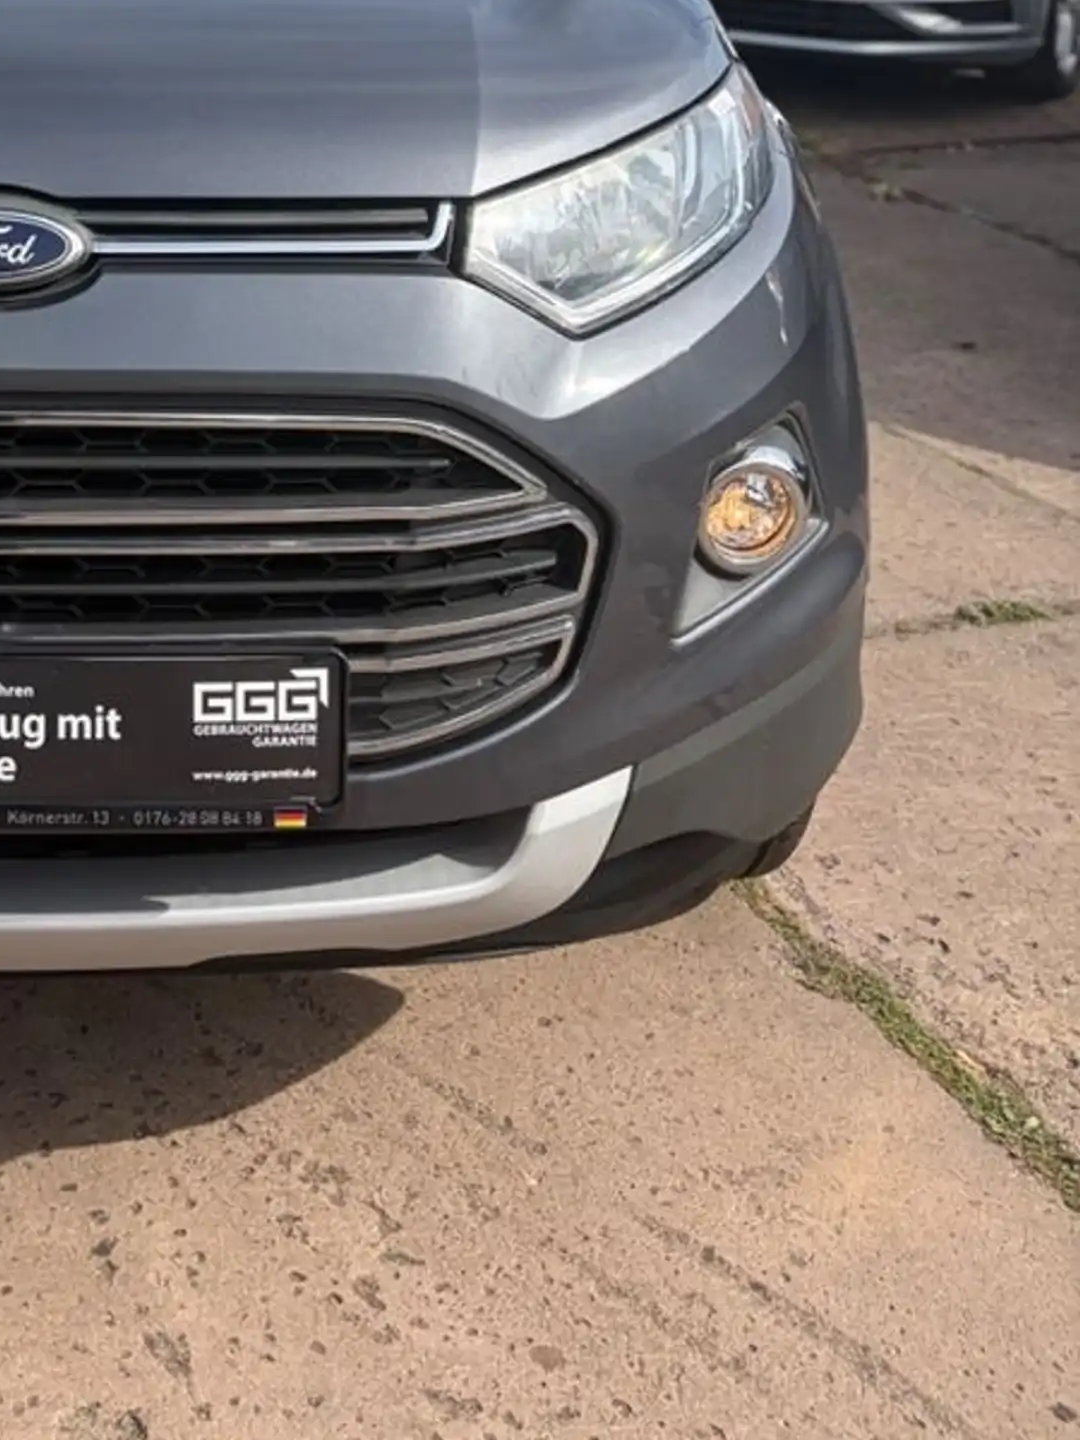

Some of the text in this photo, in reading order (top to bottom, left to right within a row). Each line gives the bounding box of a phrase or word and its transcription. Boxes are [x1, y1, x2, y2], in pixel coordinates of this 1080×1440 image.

[193, 680, 318, 723] GGG
[57, 705, 122, 741] mit
[193, 723, 318, 737] GEBRAUCHTWAGEN
[252, 735, 318, 748] GARANTIE
[192, 766, 318, 783] www.ggg-garantie.de
